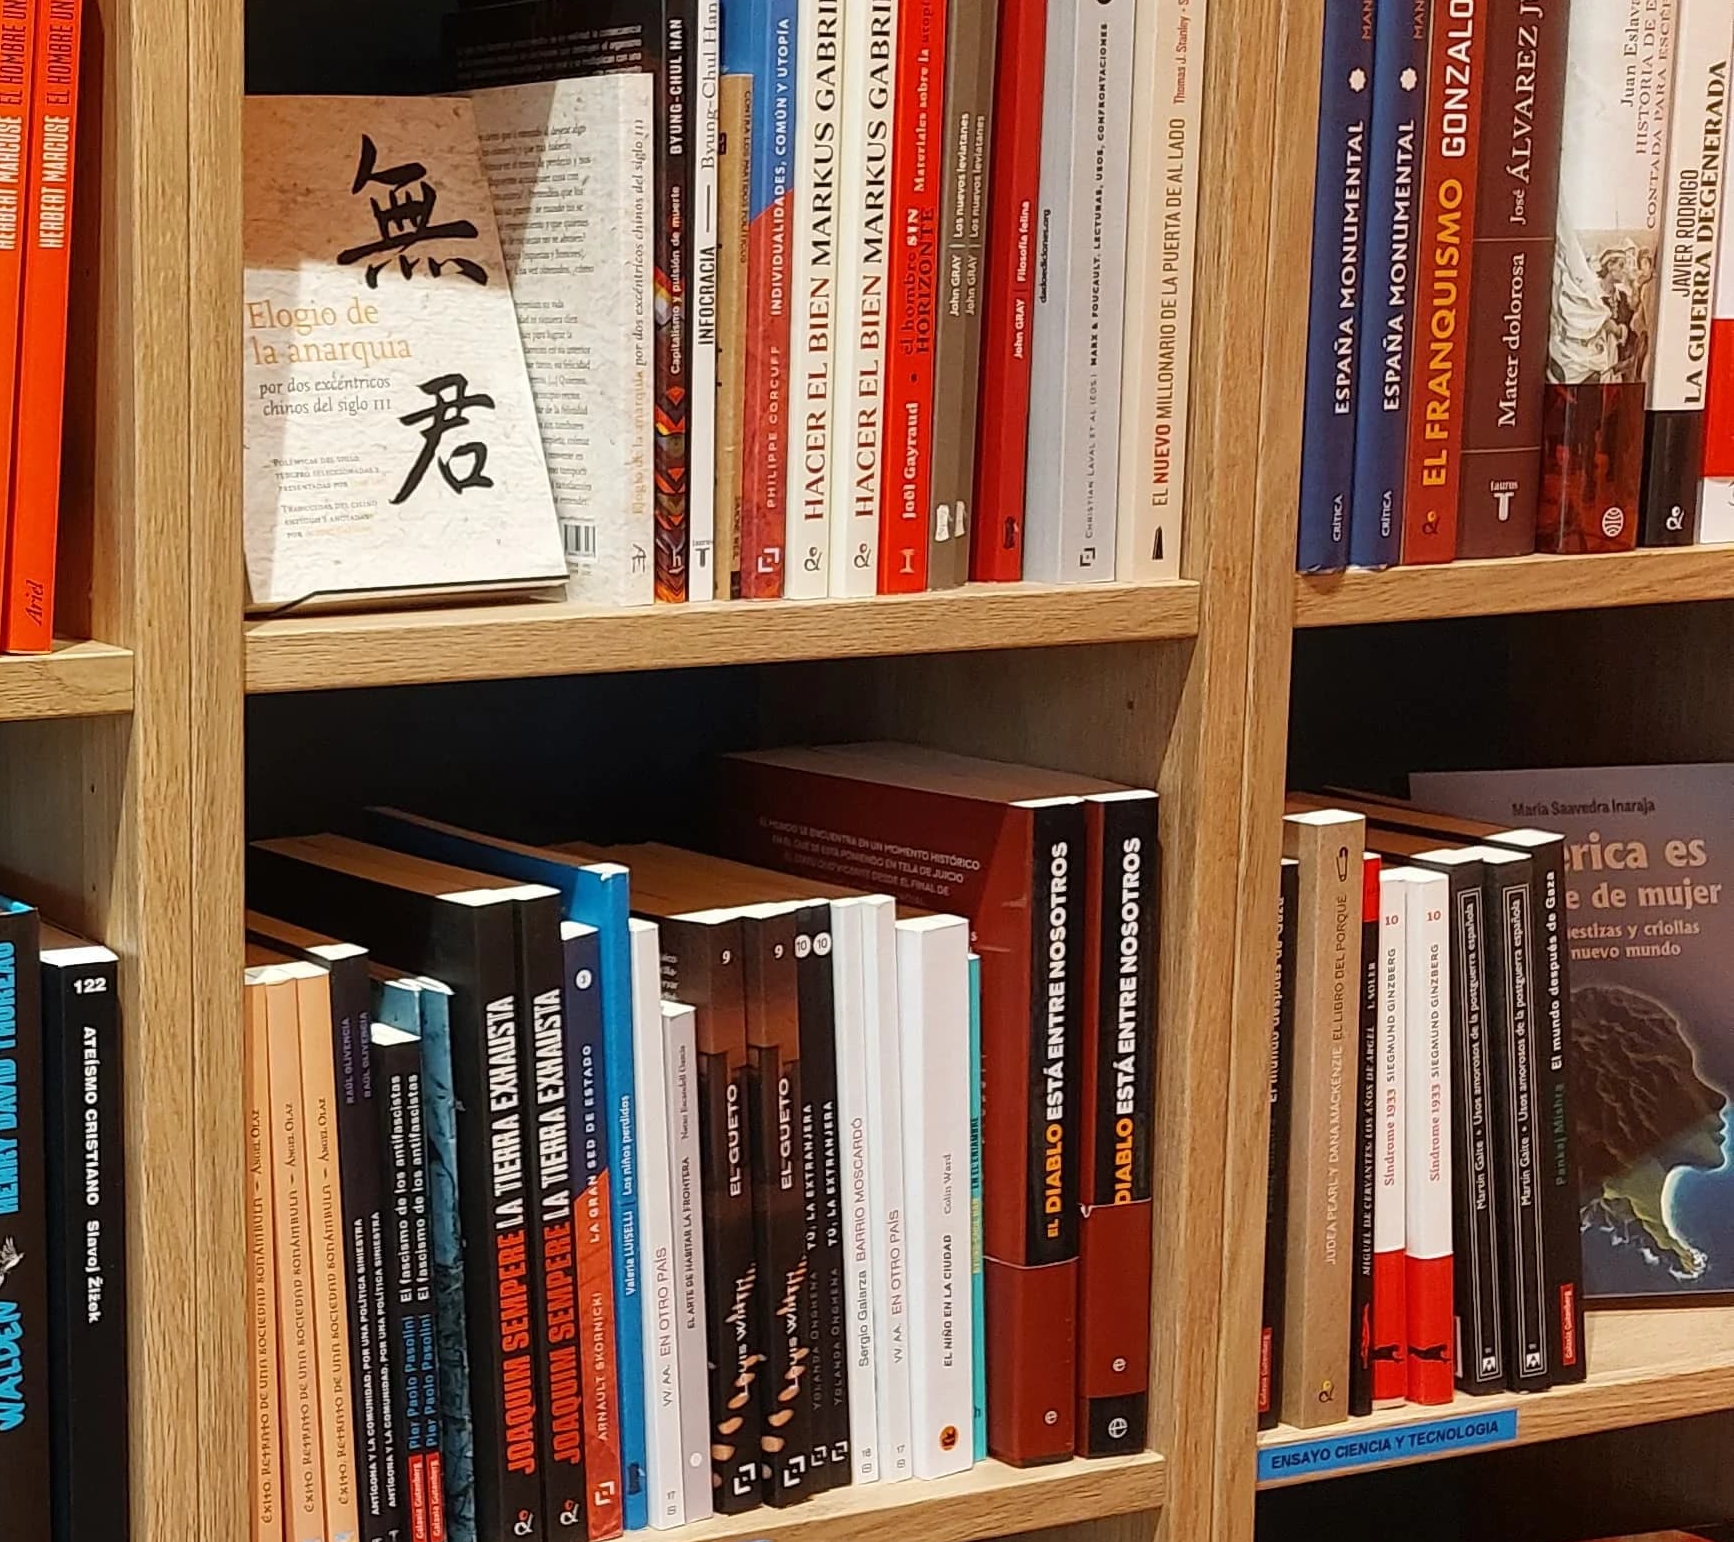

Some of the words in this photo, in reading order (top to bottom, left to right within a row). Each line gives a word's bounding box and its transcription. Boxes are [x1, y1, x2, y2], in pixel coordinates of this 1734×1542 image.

[1506, 26, 1537, 183] ÁLVAREZ
[337, 133, 490, 289] 無
[1340, 121, 1363, 307] MONUMENTAL
[1509, 189, 1525, 224] José
[249, 298, 338, 337] Elogio
[346, 297, 379, 325] de
[1425, 179, 1462, 438] FRANQUISMO
[1502, 253, 1524, 349] dolorosa
[251, 338, 280, 366] la
[288, 335, 412, 370] anarquía
[1333, 316, 1353, 413] ESPAÑA
[1497, 355, 1518, 426] Mater
[388, 371, 496, 506] 君
[1422, 449, 1446, 485] EL
[1430, 944, 1438, 1007] GINZBERG
[1430, 1010, 1439, 1077] SIEGMUND
[1431, 1083, 1440, 1112] 1933
[1429, 1116, 1439, 1181] Síndrome
[1271, 1448, 1330, 1468] ENSAYO
[1334, 1438, 1391, 1458] CIENCIA
[1395, 1435, 1404, 1448] Y
[1408, 1420, 1498, 1446] TECNOLOGIA
